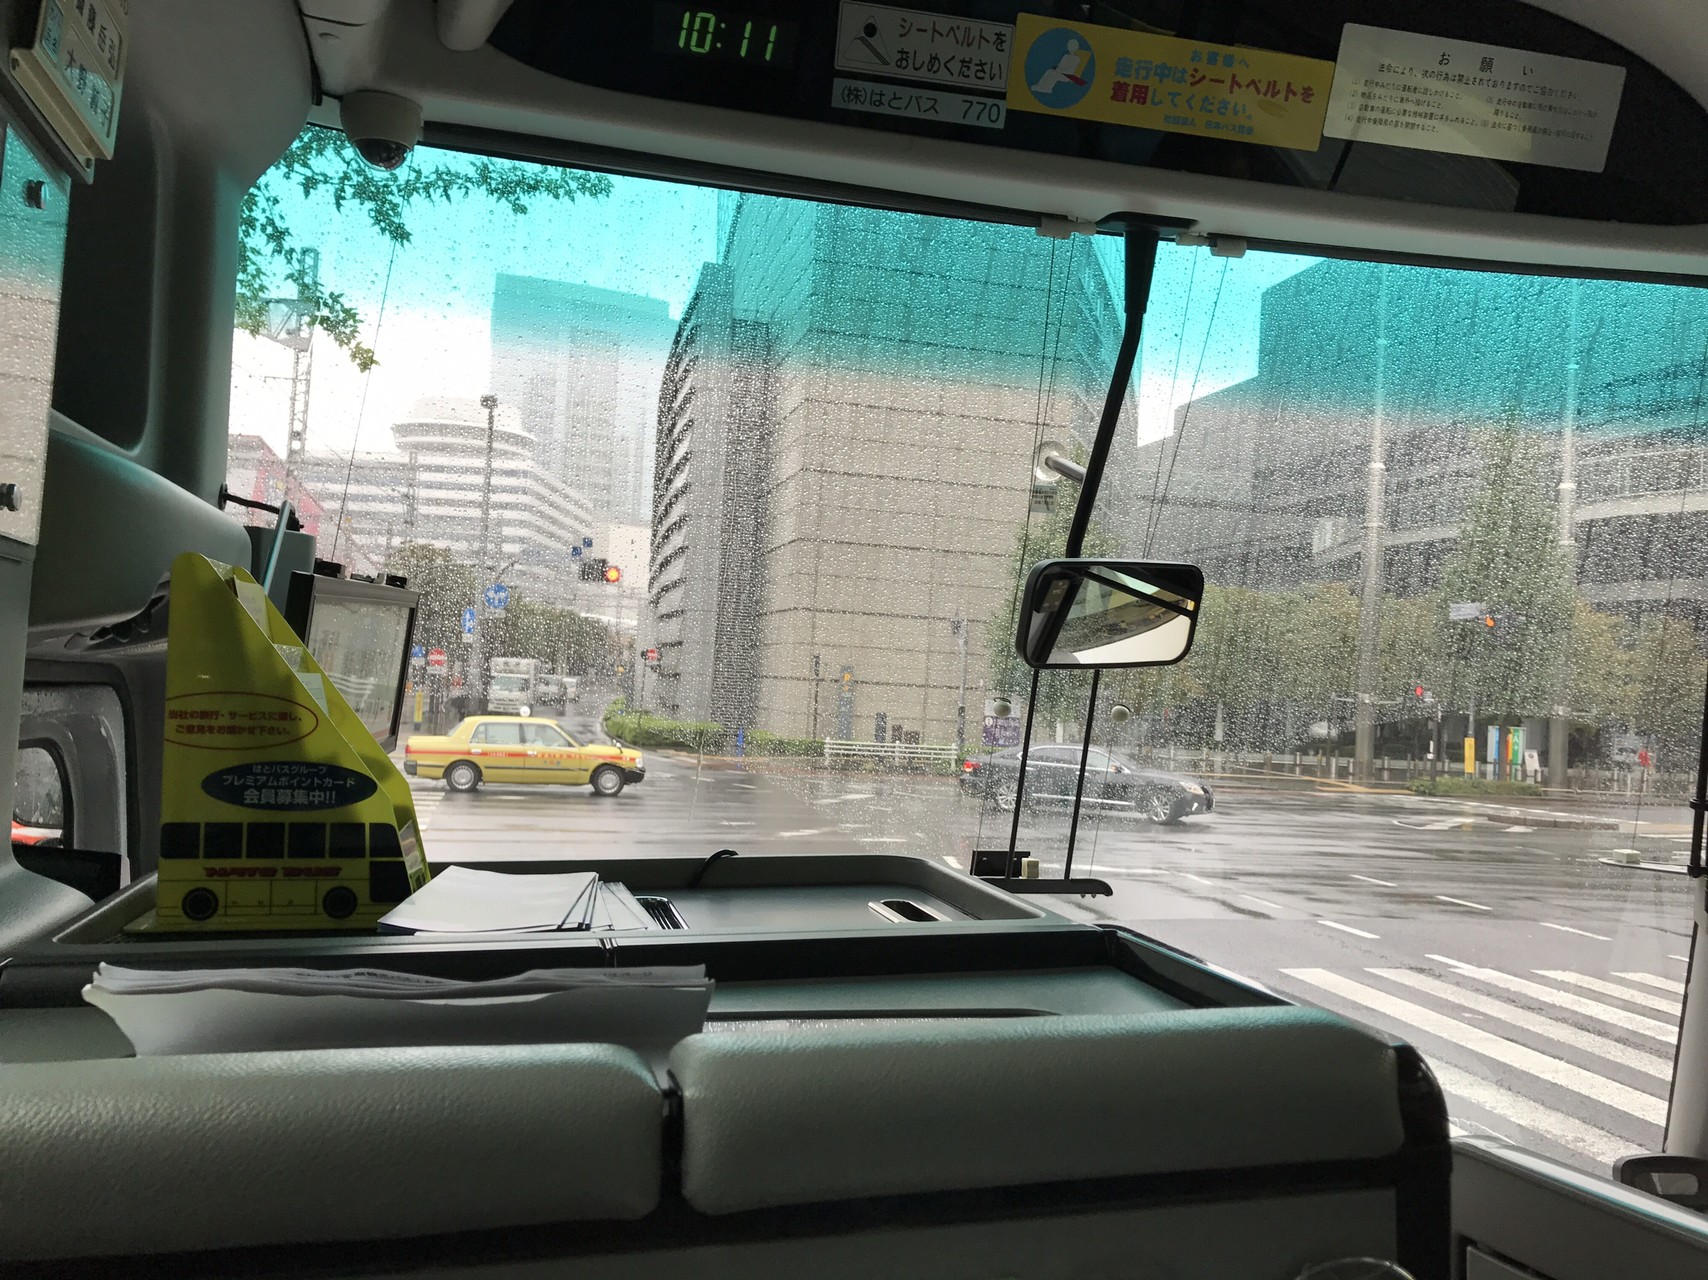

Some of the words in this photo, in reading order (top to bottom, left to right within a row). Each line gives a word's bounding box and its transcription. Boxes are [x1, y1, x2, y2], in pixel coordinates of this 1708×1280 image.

[679, 11, 777, 61] 10:11
[898, 17, 1007, 52] シートベルトを
[895, 48, 1002, 81] おしめください
[1114, 56, 1315, 104] 走行中はシートベルトを
[962, 99, 1001, 124] 770
[1110, 80, 1253, 121] 着用してください。
[222, 775, 356, 788] プレミアムポイントカード
[252, 765, 327, 775] はとバスグループ
